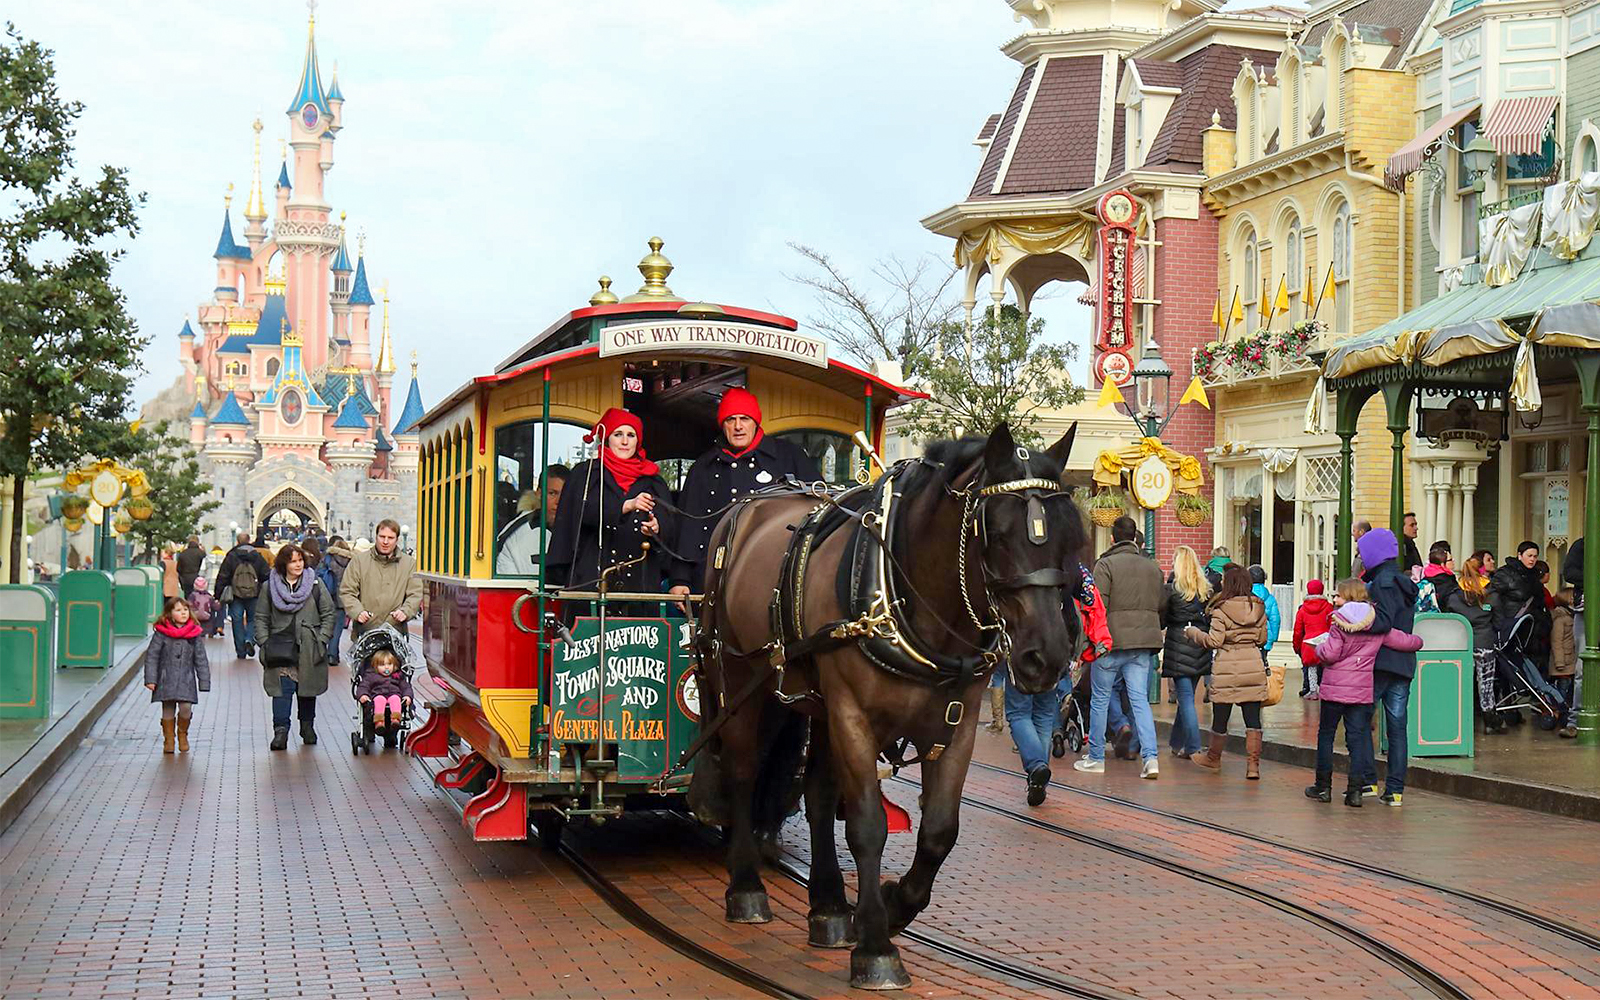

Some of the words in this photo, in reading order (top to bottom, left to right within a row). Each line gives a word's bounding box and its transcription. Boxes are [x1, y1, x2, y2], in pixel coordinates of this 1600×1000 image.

[1112, 229, 1125, 272] ICE
[1111, 277, 1125, 345] CREAM
[613, 329, 647, 348] ONE
[651, 326, 682, 343] WAY
[686, 326, 819, 358] TRANSPORTATION
[97, 482, 115, 494] 20
[1141, 472, 1165, 489] 20
[563, 625, 659, 662] DESTNATIONS
[555, 665, 601, 706] TOWN
[604, 656, 666, 687] SQUARE
[621, 685, 659, 709] AND
[553, 709, 617, 742] CENTRAL
[621, 709, 665, 741] PLAZA
